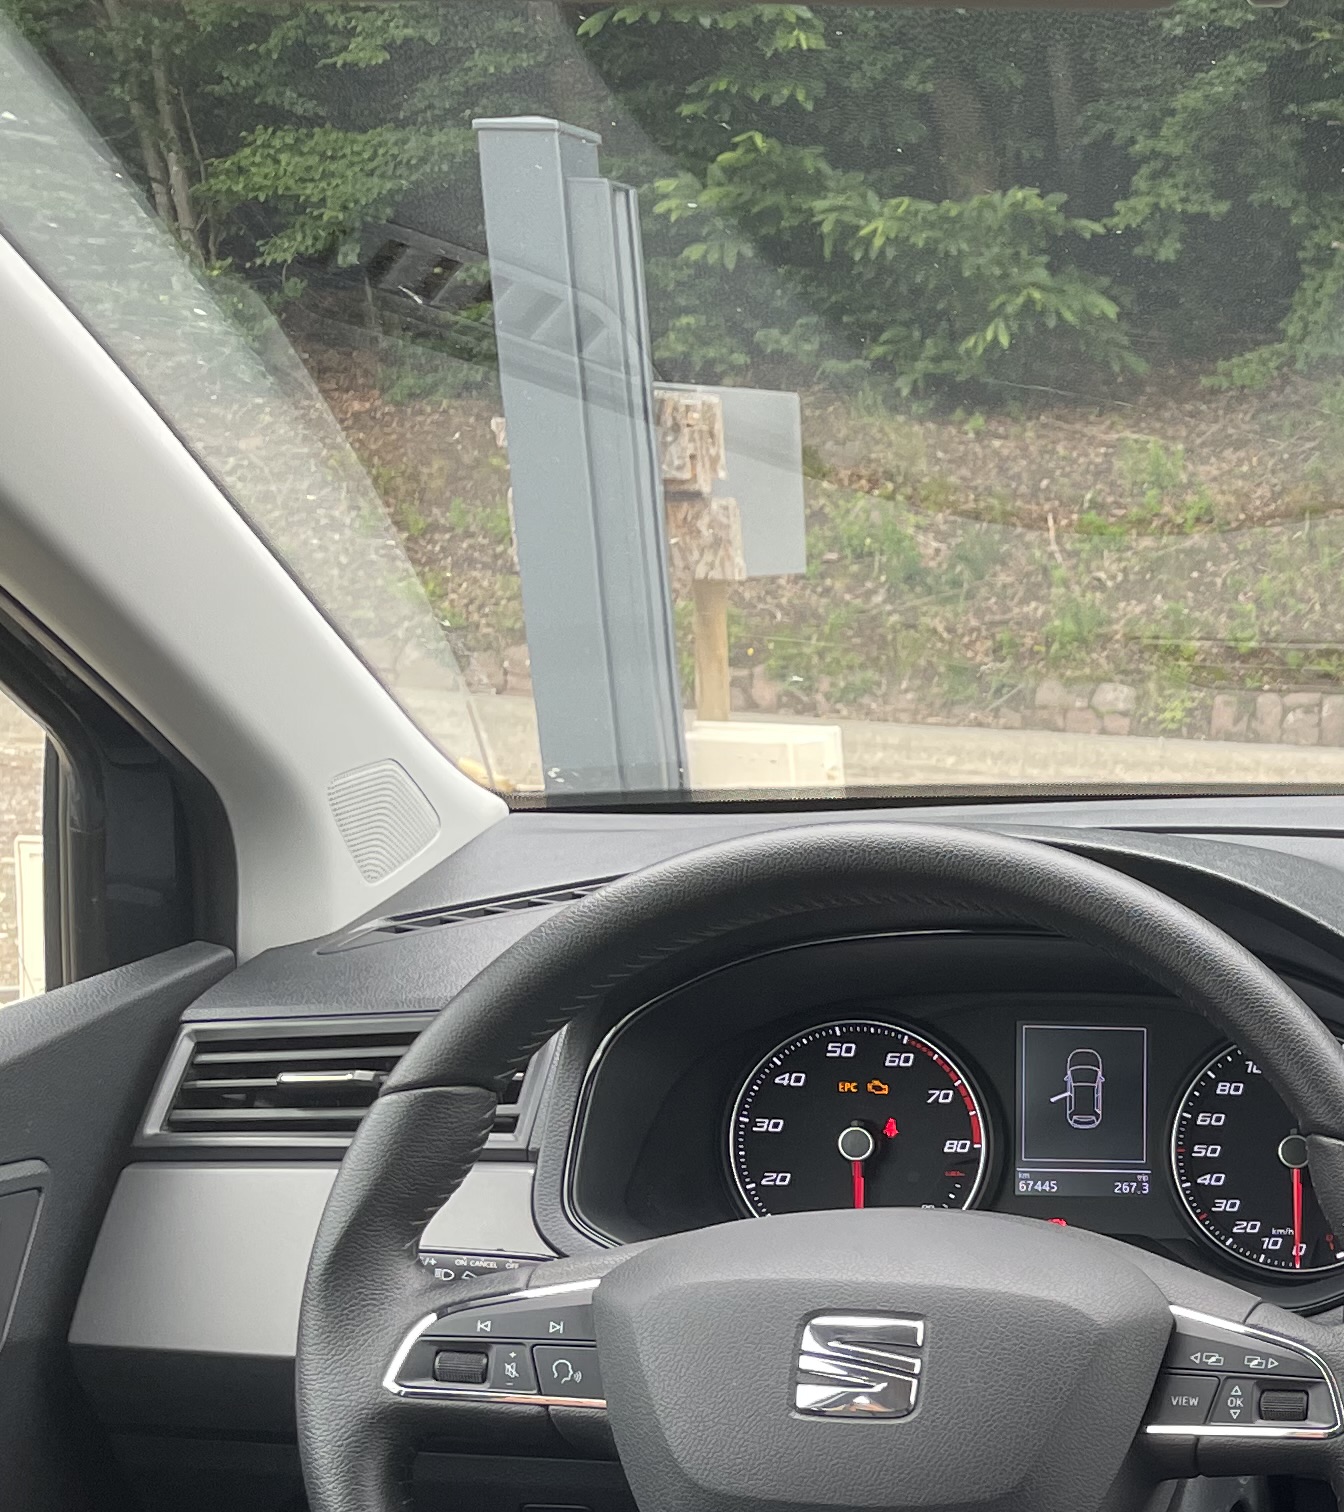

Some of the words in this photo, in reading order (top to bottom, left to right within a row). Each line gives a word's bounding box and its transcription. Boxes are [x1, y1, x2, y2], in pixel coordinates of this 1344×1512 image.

[826, 1042, 856, 1058] 50
[884, 1052, 915, 1067] 60
[774, 1072, 806, 1087] 40
[838, 1081, 859, 1093] EPC
[1215, 1082, 1245, 1095] 80
[926, 1089, 953, 1103] 70
[752, 1118, 784, 1133] 30
[1196, 1113, 1226, 1126] 60
[943, 1139, 970, 1153] 80
[1191, 1145, 1221, 1158] 50
[760, 1172, 791, 1186] 20
[1018, 1171, 1030, 1180] km
[1137, 1173, 1149, 1182] trip
[1196, 1172, 1226, 1186] 40
[1018, 1180, 1058, 1193] 67445
[1114, 1182, 1150, 1194] 267.3
[1211, 1199, 1240, 1212] 30
[1232, 1220, 1261, 1233] 20
[1260, 1237, 1283, 1250] 10
[454, 1258, 467, 1267] ON
[469, 1259, 498, 1269] CANCEL
[1171, 1395, 1199, 1407] VIEW
[1227, 1397, 1244, 1408] OK
